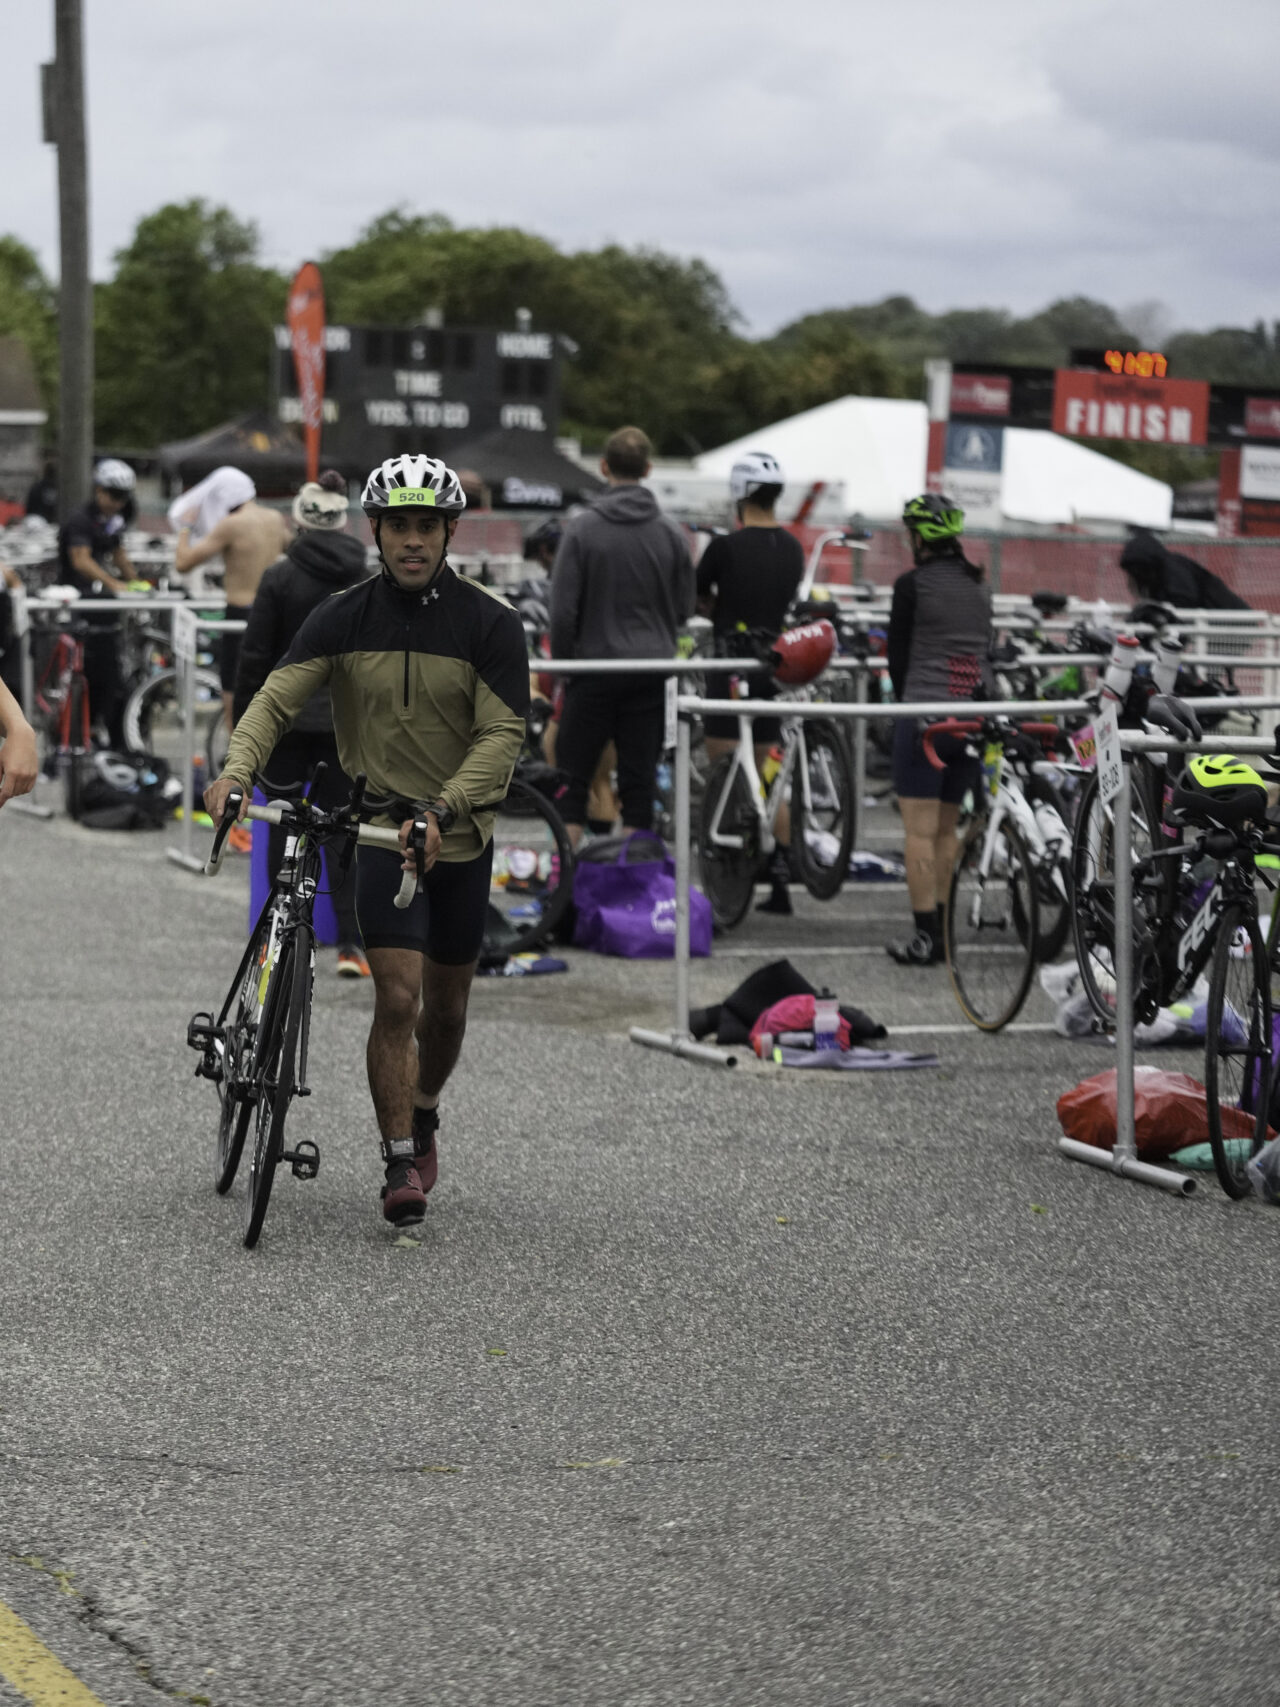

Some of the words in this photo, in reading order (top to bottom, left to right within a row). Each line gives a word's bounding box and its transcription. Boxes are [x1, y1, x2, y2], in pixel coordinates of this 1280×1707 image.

[497, 332, 553, 359] HOME
[394, 370, 442, 397] TIME
[413, 403, 440, 427] TO
[442, 403, 469, 428] GO
[1065, 398, 1192, 444] FINISH
[400, 492, 424, 502] 520
